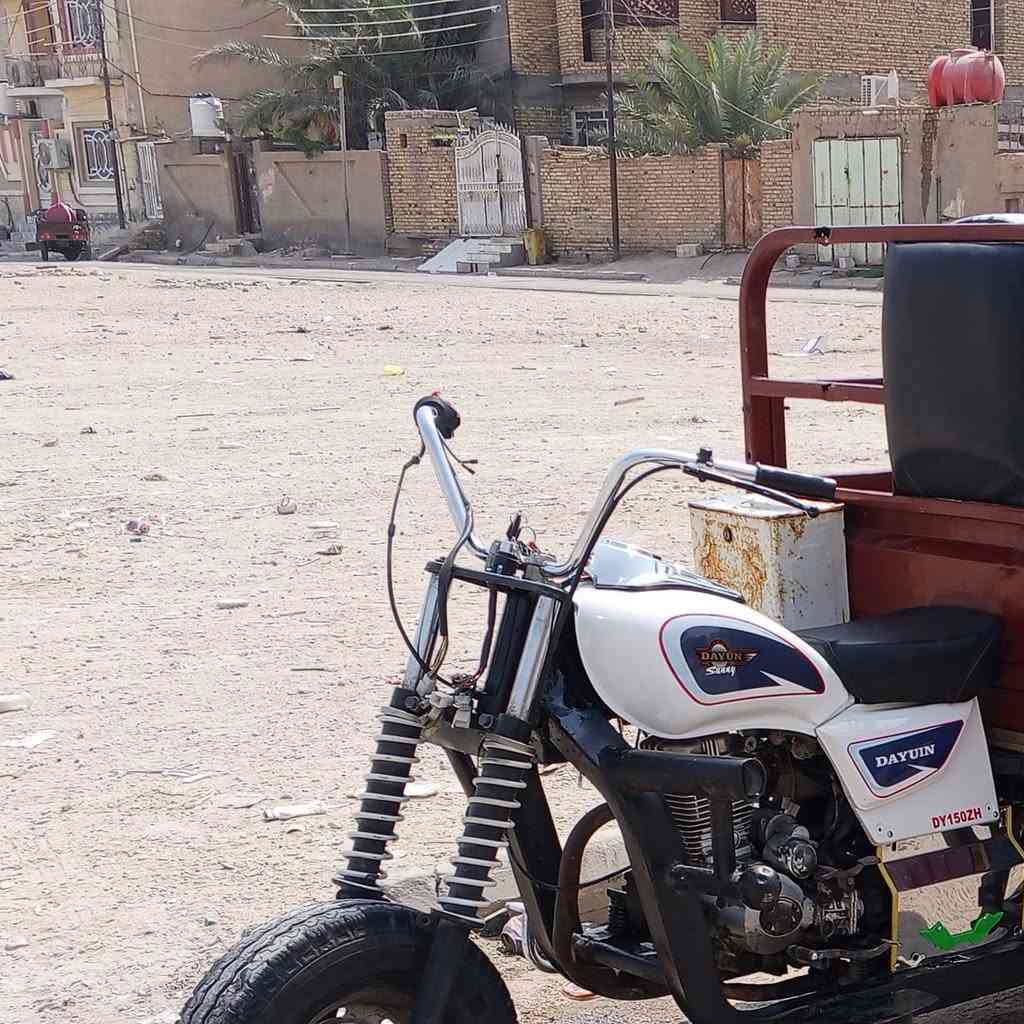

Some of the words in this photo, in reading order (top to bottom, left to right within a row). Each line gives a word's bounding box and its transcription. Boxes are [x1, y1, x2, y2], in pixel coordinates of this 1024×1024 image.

[701, 651, 742, 661] DAYUN
[875, 744, 936, 768] DAYUIN
[931, 807, 983, 829] DY150ZH
